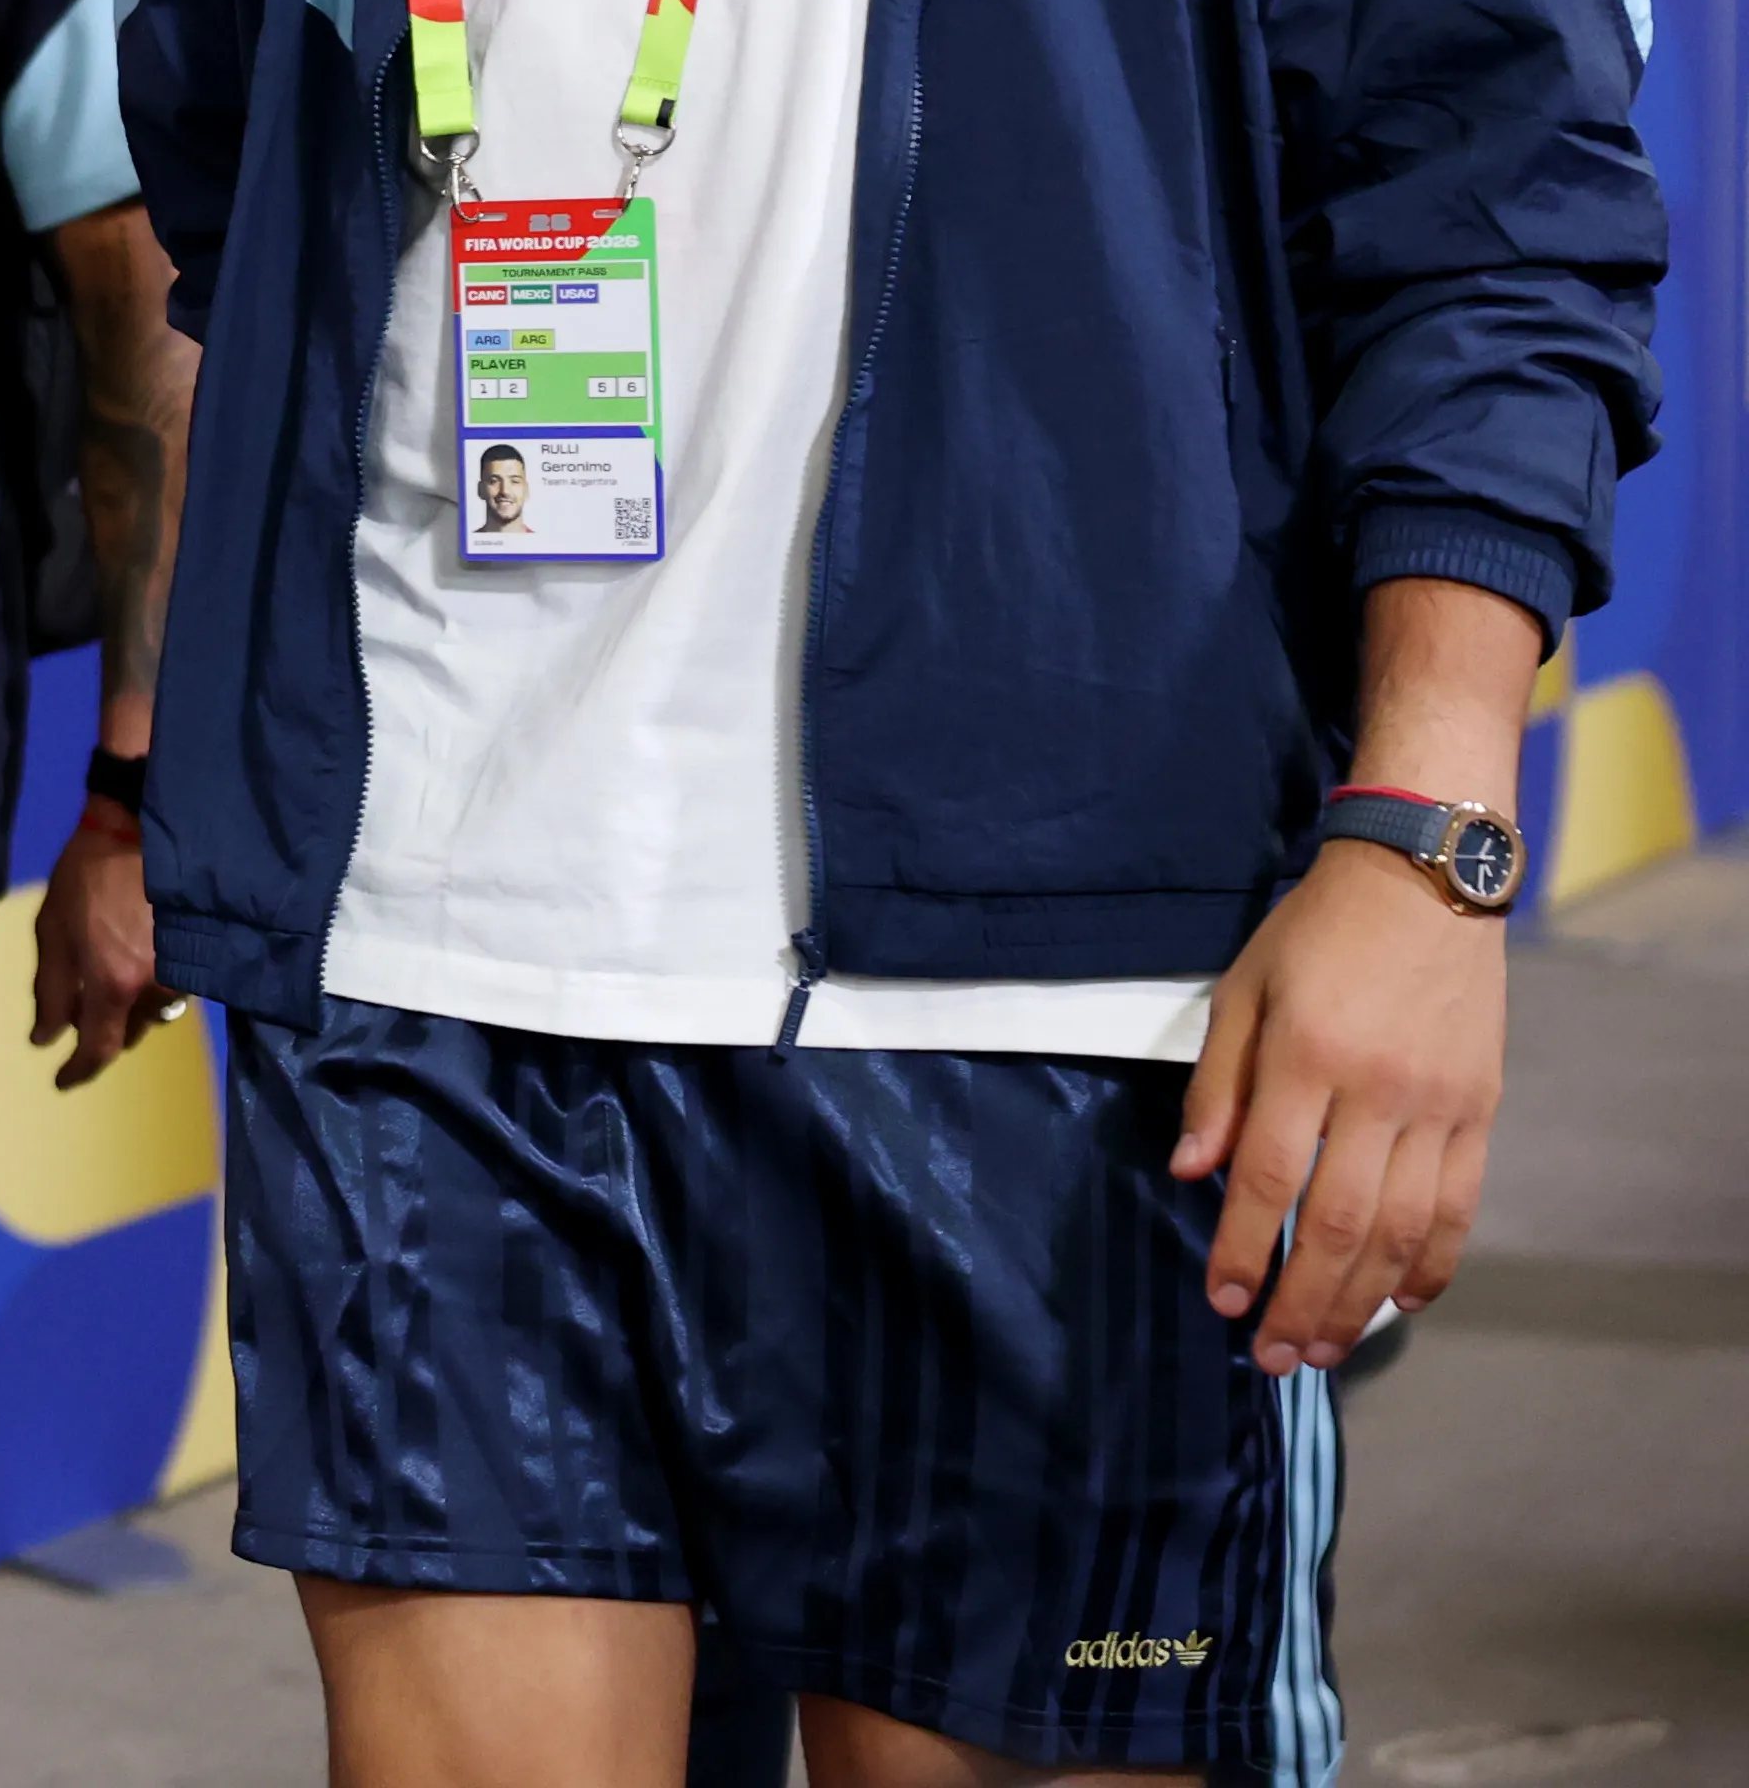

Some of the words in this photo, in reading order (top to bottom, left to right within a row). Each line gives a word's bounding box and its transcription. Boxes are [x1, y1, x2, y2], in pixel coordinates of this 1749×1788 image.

[465, 237, 497, 251] FIFA
[499, 236, 552, 250] WORLD
[555, 236, 584, 249] CUP
[587, 235, 640, 248] 2026
[502, 268, 576, 278] TOURNAMENT
[578, 267, 607, 276] PASS
[468, 289, 505, 301] CANC
[513, 288, 550, 300] MEXC
[559, 288, 595, 299] USAC
[475, 335, 501, 345] ARG
[520, 334, 547, 344] ARG
[471, 359, 526, 370] PLAYER
[480, 384, 488, 394] 1
[509, 383, 518, 393] 2
[598, 383, 606, 392] 5
[628, 383, 637, 392] 6
[541, 444, 579, 455] RULLI
[541, 462, 611, 473] Geronimo
[1065, 1631, 1171, 1668] adidas
